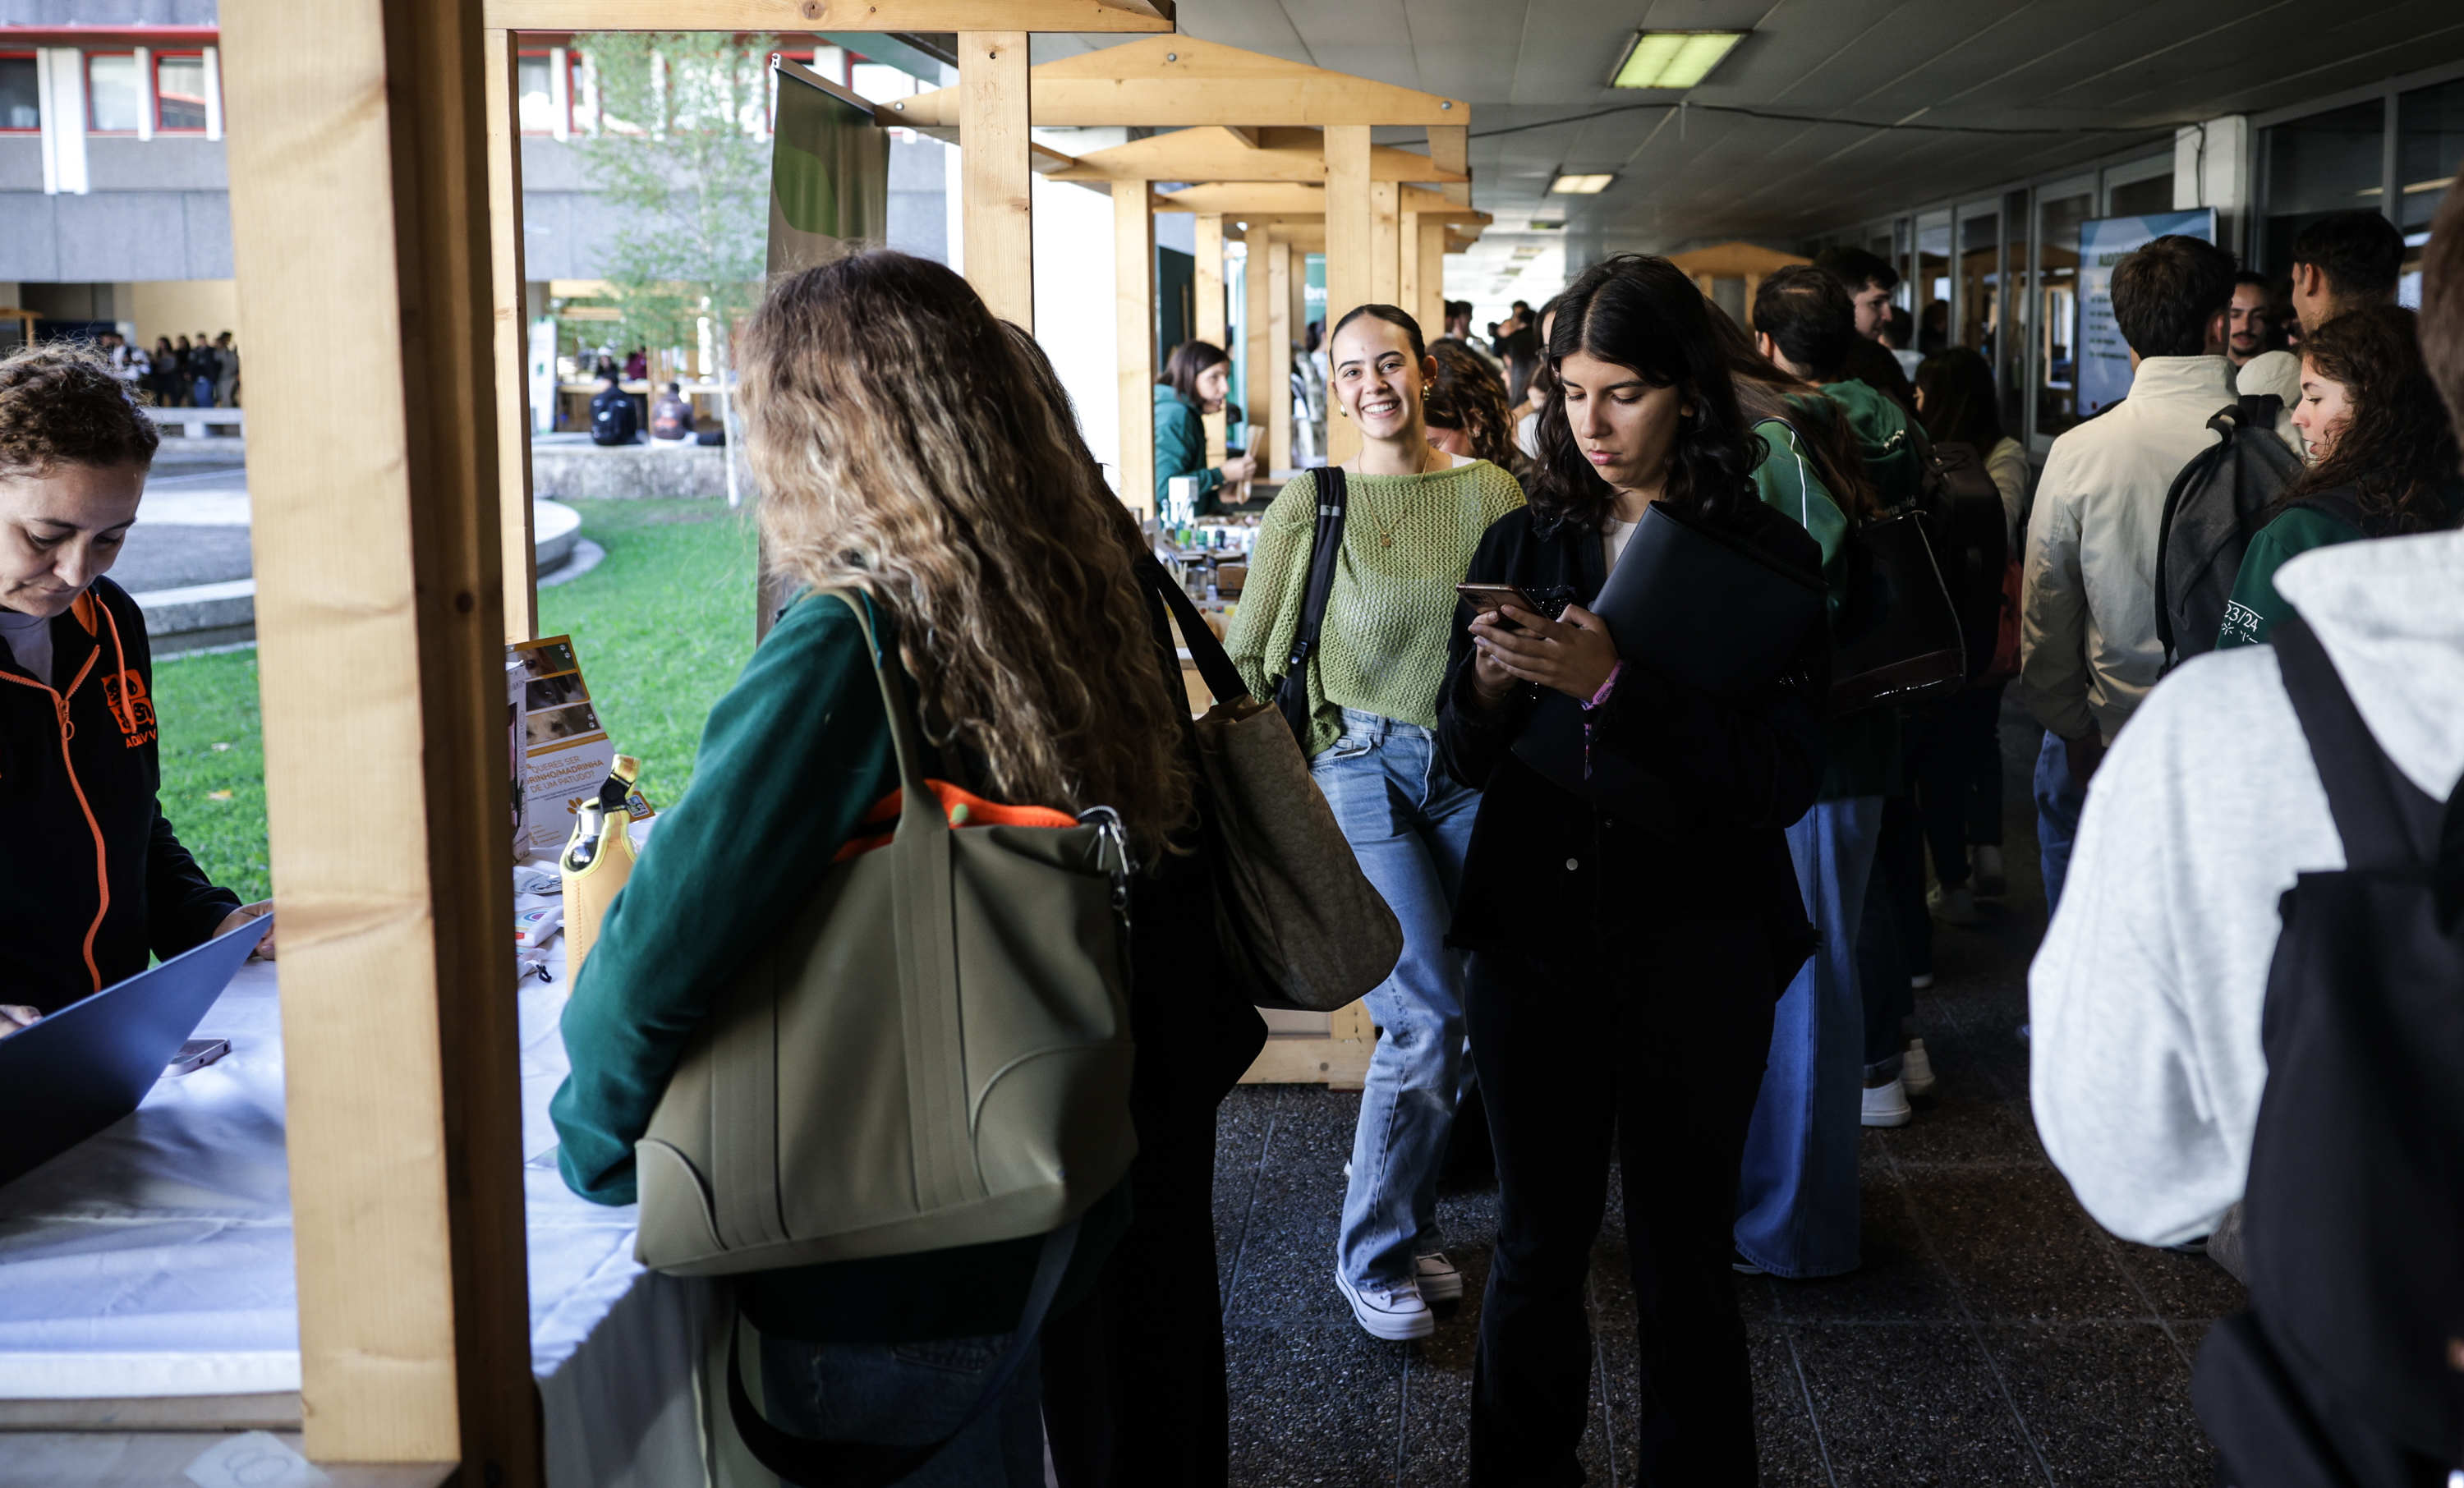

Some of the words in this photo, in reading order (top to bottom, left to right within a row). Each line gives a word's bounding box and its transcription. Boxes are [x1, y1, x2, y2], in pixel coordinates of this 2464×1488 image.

[531, 760, 564, 774] QUERES
[564, 755, 581, 765] SER
[530, 784, 543, 793] DE
[544, 781, 558, 790] UM
[558, 770, 595, 786] PATUDO?
